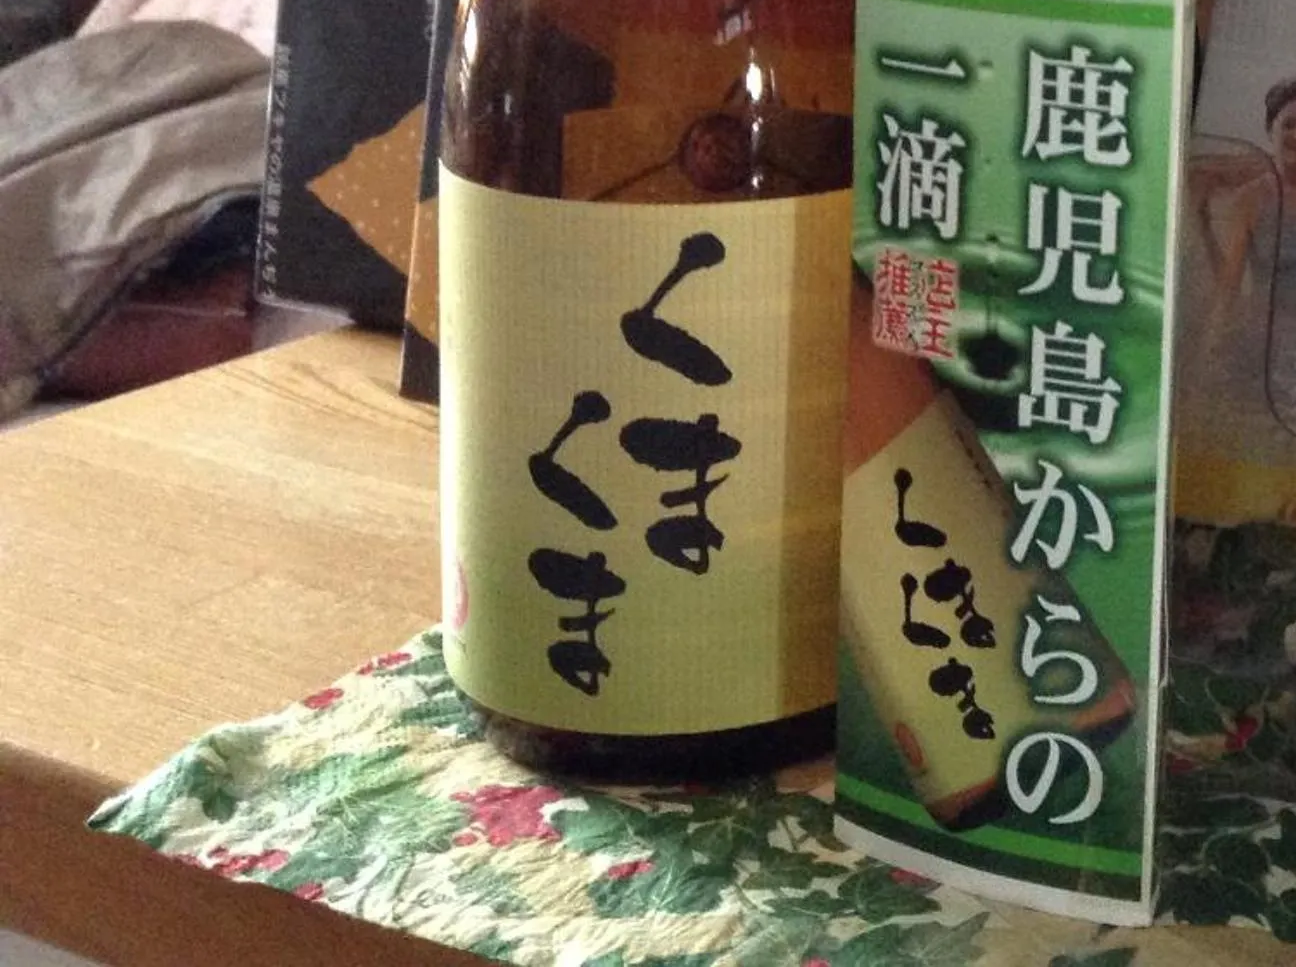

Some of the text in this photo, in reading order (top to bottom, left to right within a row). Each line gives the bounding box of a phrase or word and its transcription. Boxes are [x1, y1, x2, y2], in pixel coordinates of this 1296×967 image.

[877, 53, 966, 240] 一滴
[1005, 44, 1134, 825] 鹿児島からの
